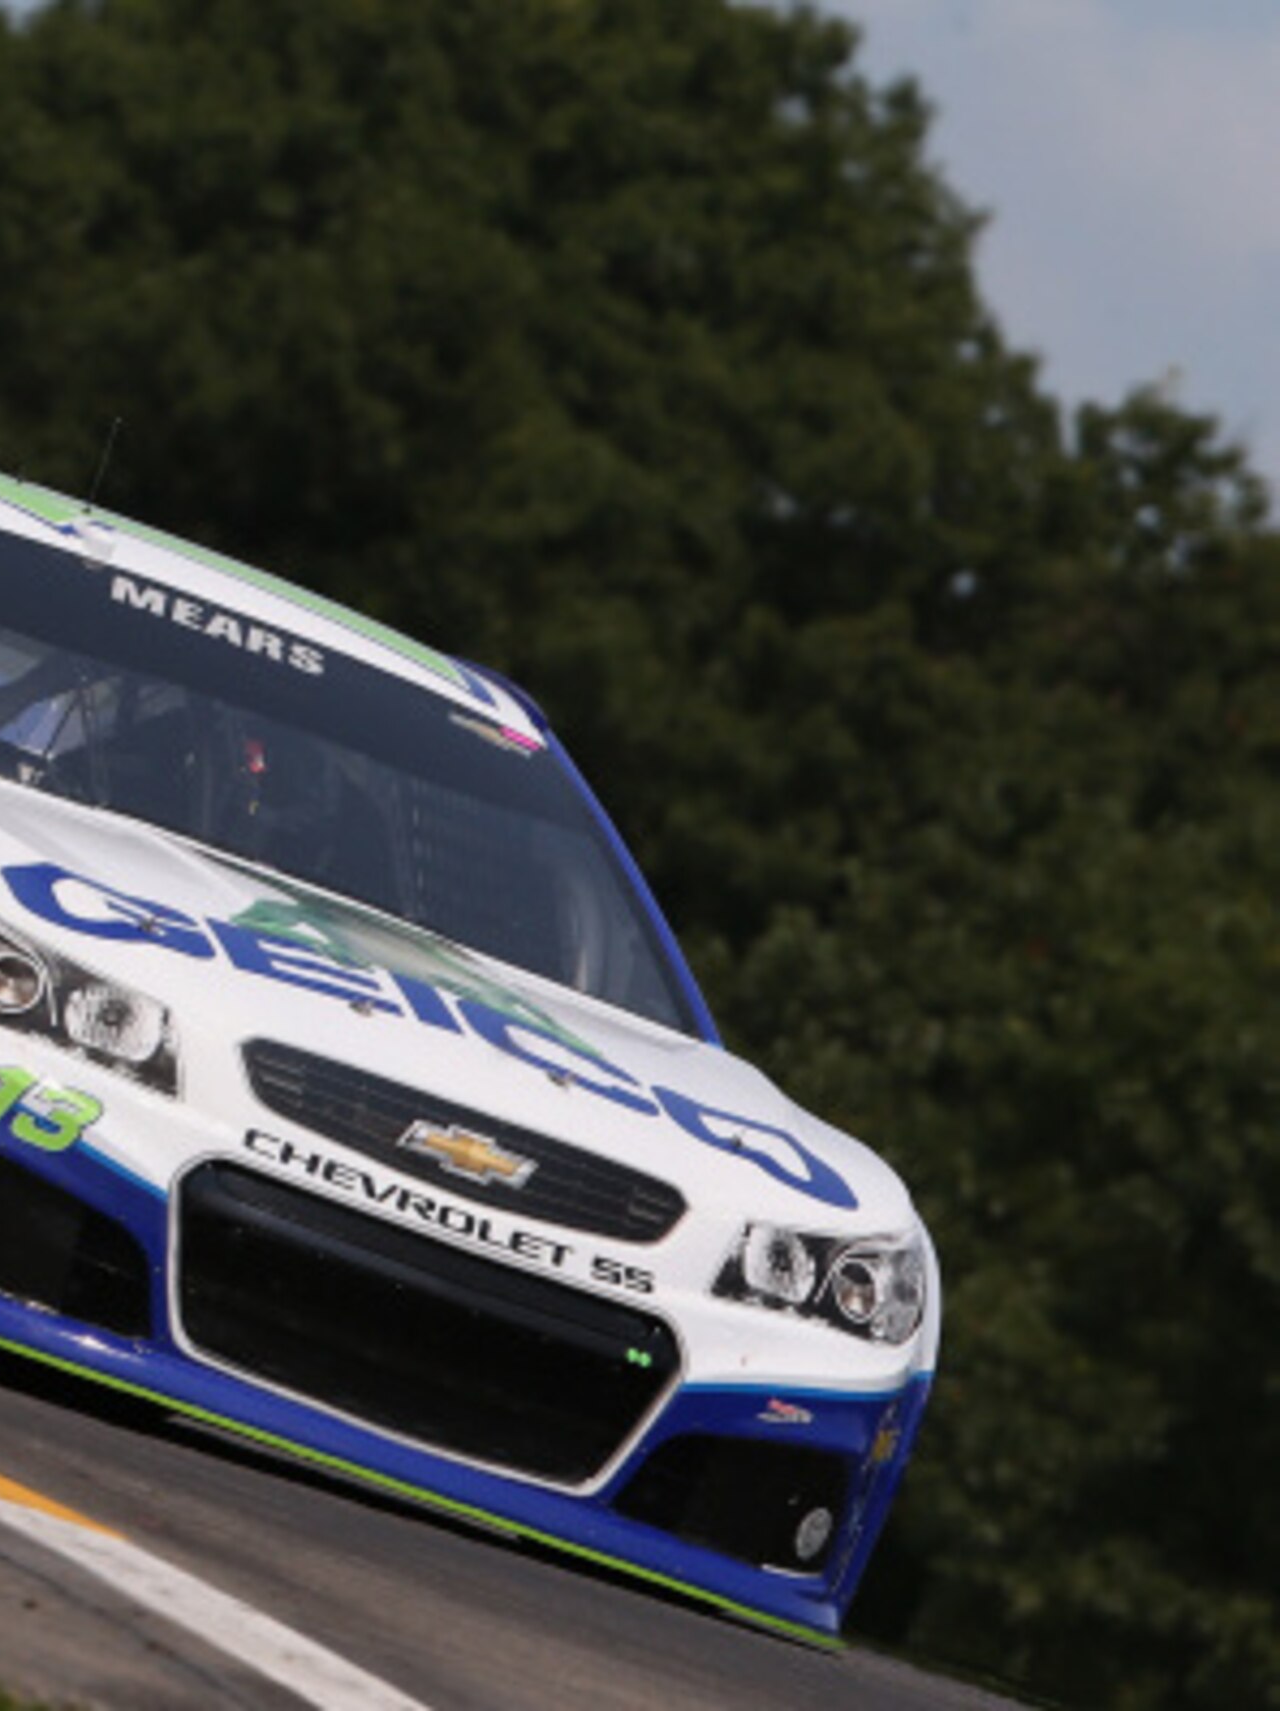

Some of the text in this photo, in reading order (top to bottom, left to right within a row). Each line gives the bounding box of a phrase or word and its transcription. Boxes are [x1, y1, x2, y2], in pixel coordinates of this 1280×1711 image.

[110, 575, 325, 675] MEARS
[0, 861, 859, 1211] GEICO
[242, 1128, 657, 1295] CHEVROLET SS
